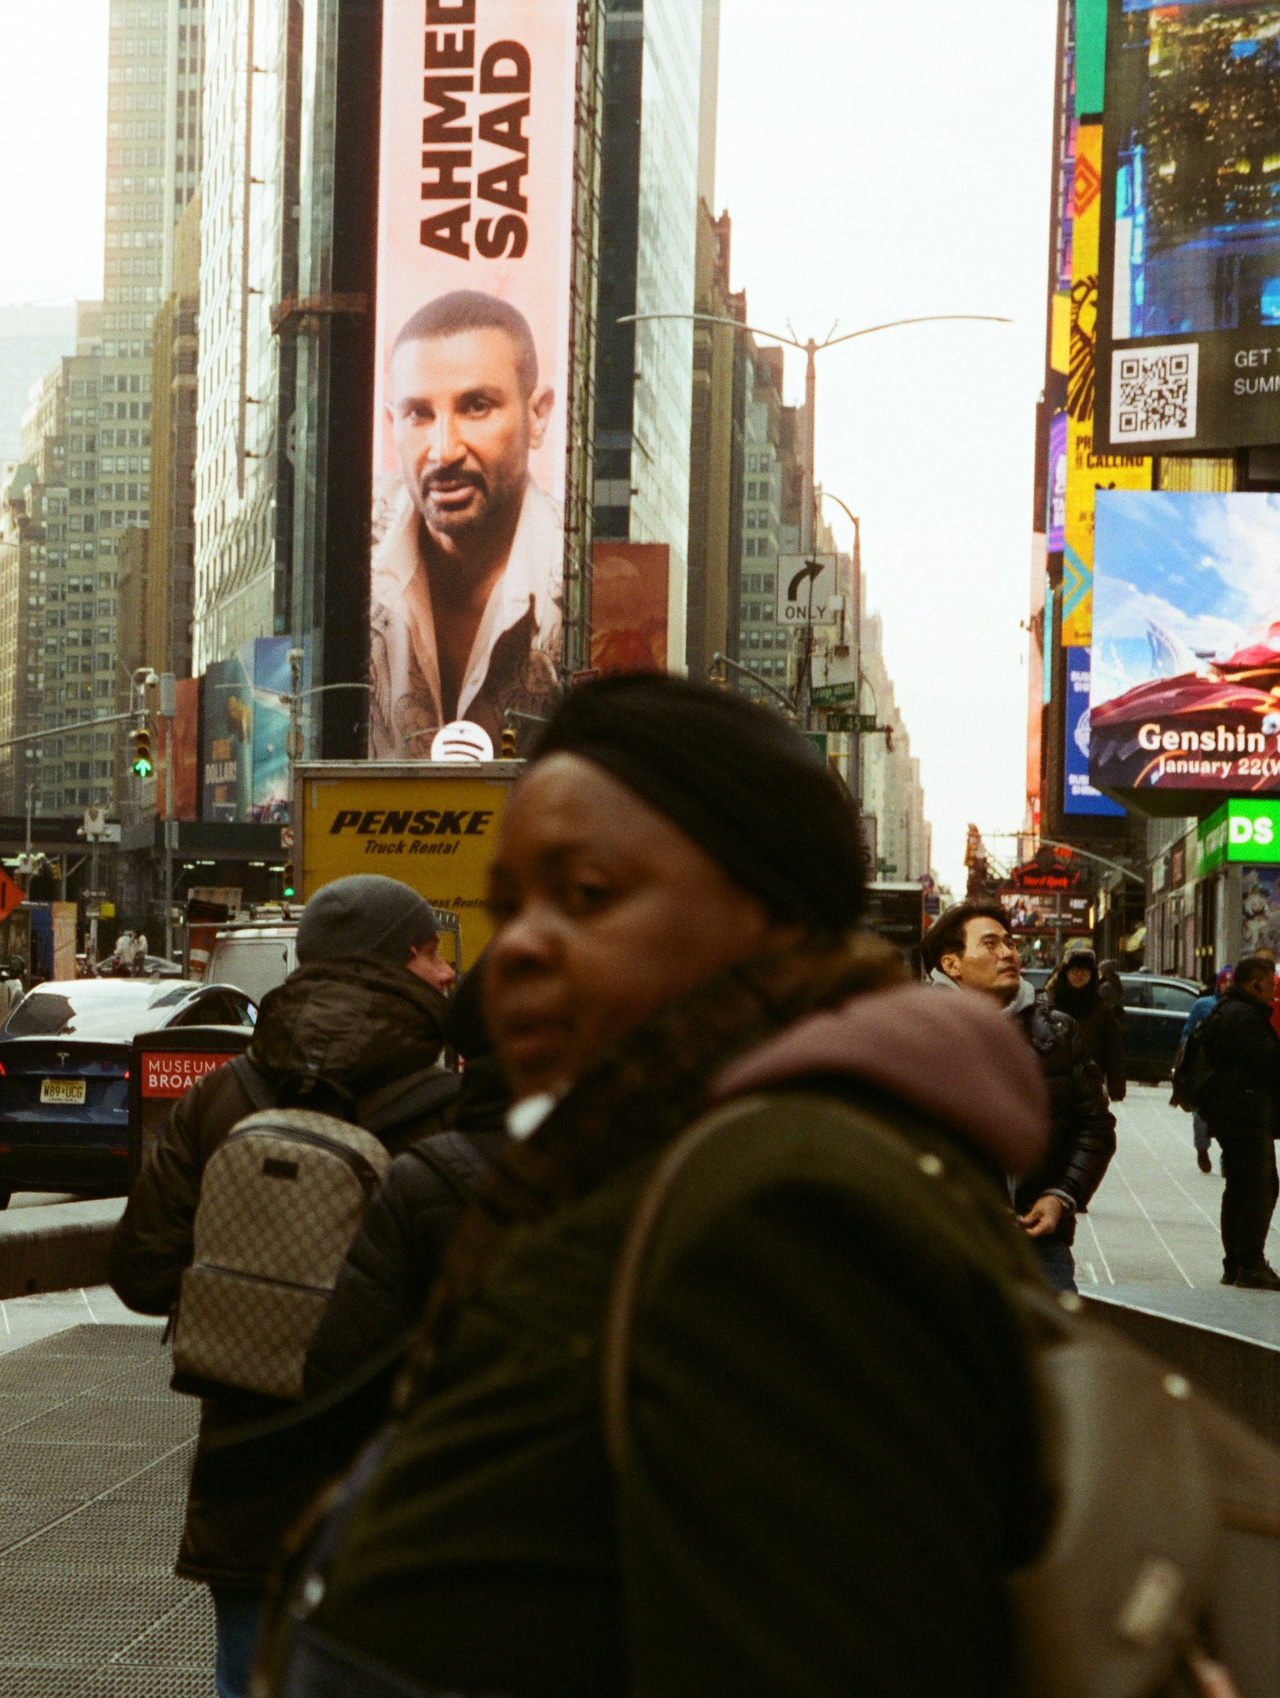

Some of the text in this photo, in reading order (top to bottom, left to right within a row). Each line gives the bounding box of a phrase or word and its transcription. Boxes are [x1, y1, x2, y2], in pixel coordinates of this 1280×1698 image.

[475, 39, 531, 259] SAAD
[1234, 348, 1271, 368] GET
[785, 606, 827, 620] ONLY
[1138, 723, 1266, 753] Genshin
[1158, 756, 1232, 779] January
[329, 810, 494, 835] PENSKE
[1228, 816, 1273, 844] DS
[364, 839, 460, 855] Truck Rental
[148, 1059, 216, 1074] MUSEUM
